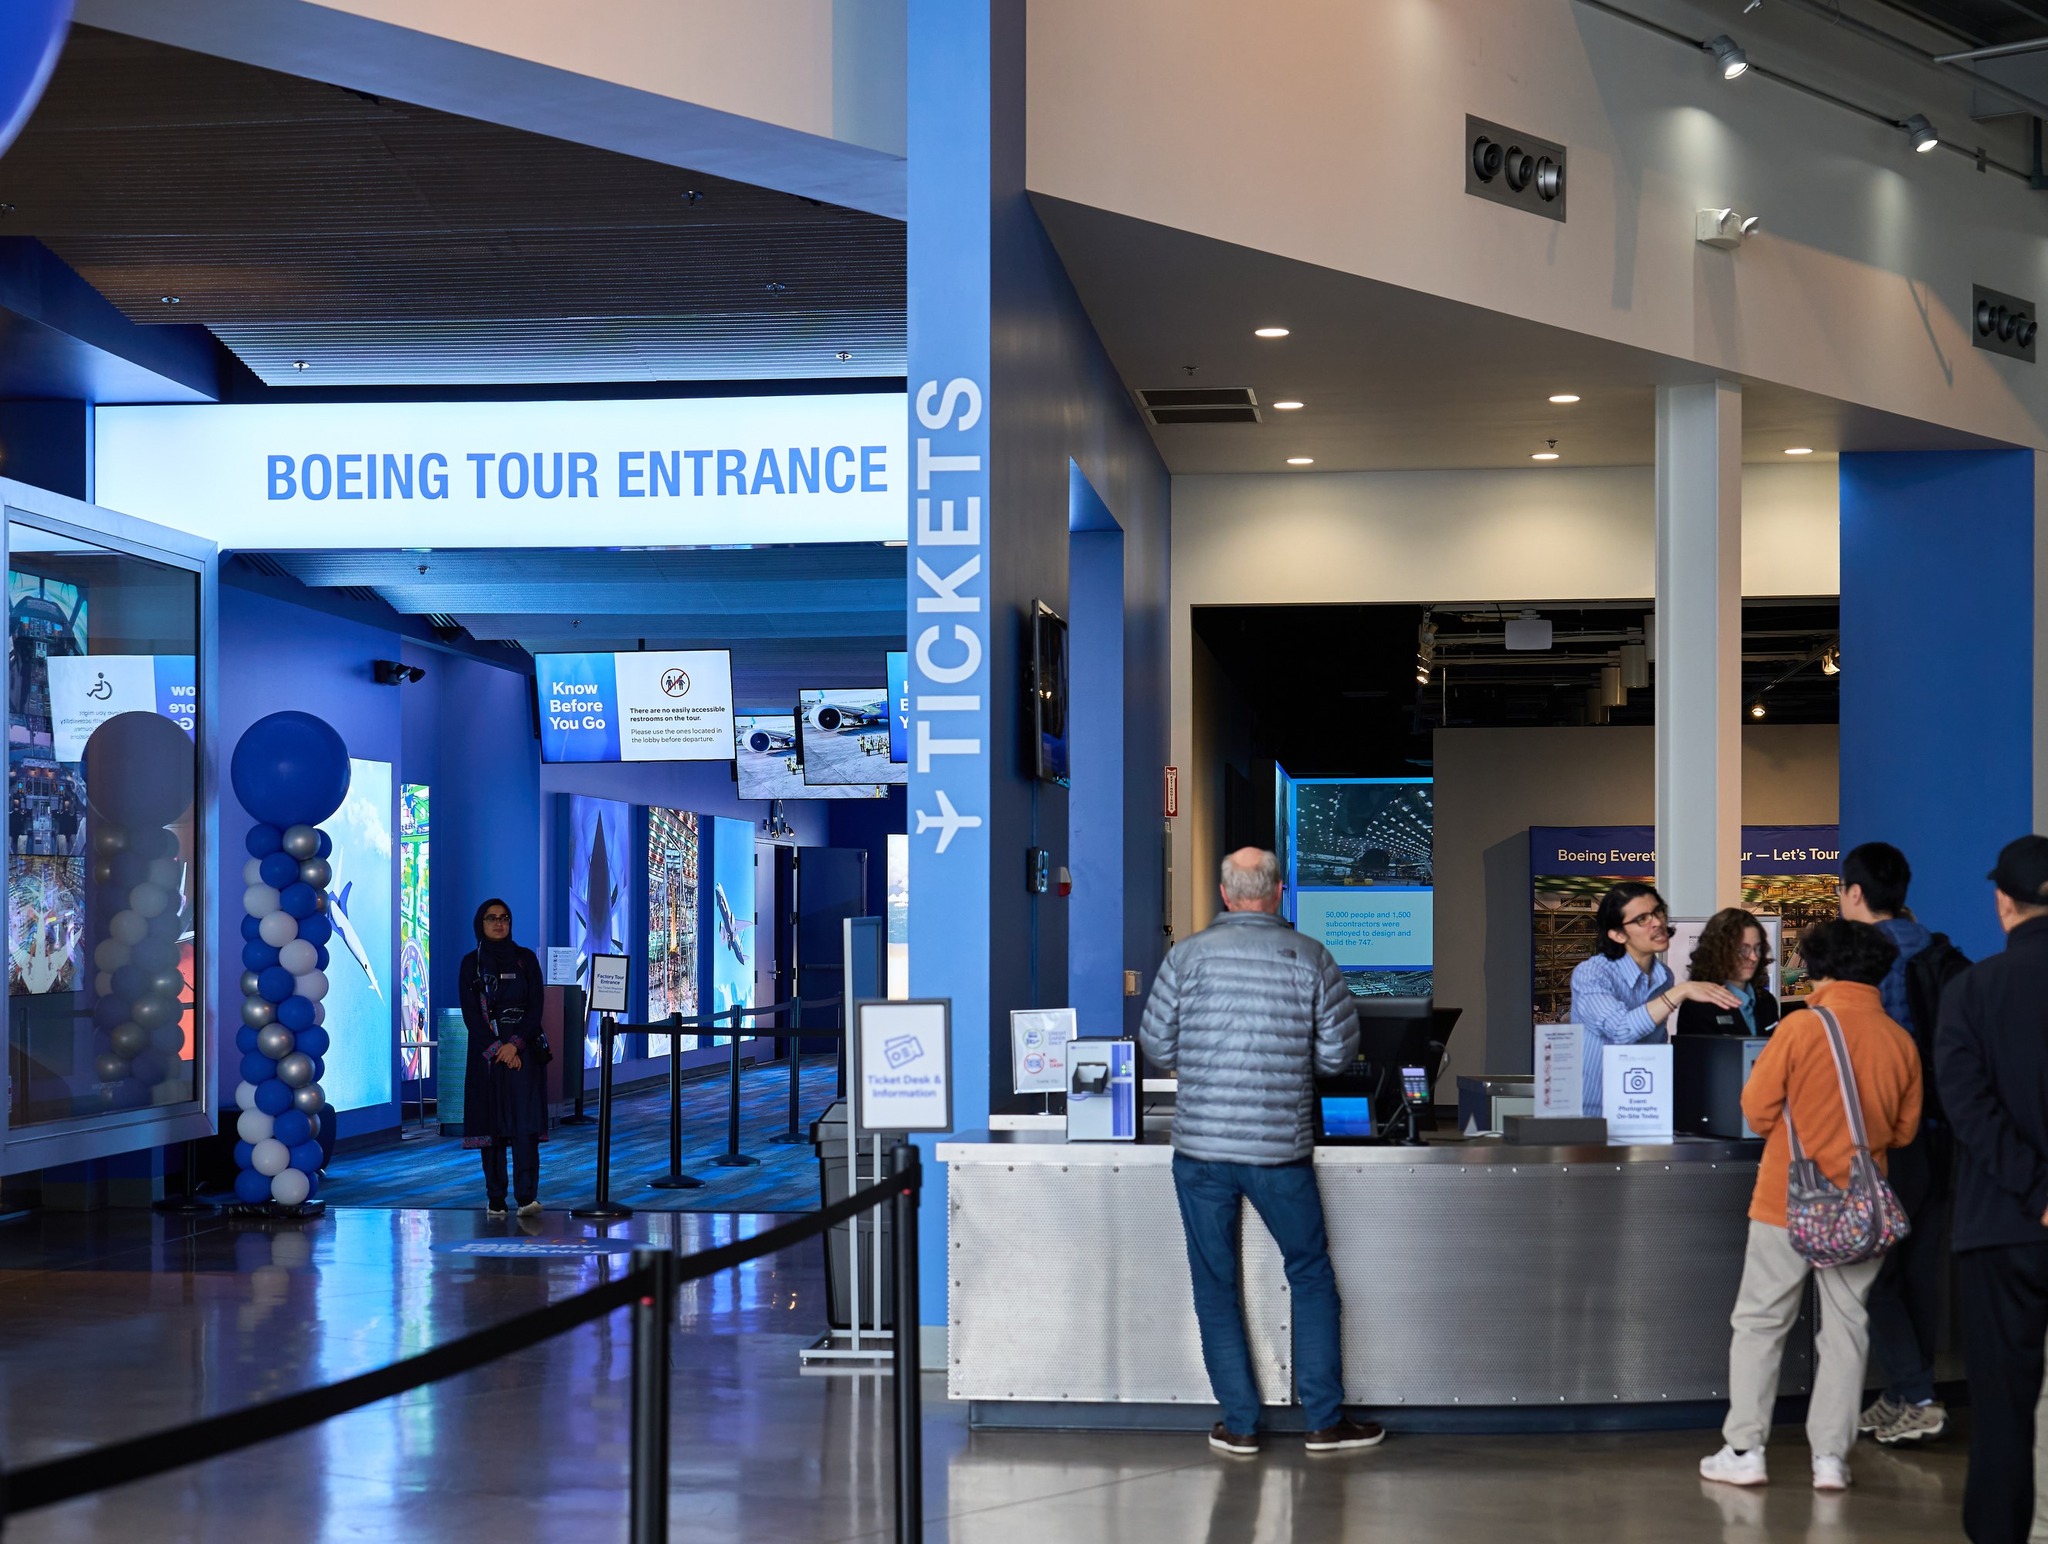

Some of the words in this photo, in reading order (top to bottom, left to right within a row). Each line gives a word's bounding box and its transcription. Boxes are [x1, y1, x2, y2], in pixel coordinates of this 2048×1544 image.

[266, 452, 449, 501] BOEING
[467, 450, 599, 500] TOUR
[618, 445, 888, 499] ENTRANCE
[915, 376, 982, 773] TICKETS
[552, 681, 598, 695] Know
[549, 699, 603, 713] Before
[672, 706, 690, 714] easily
[549, 716, 579, 730] You
[582, 716, 606, 730] Go
[682, 736, 714, 744] departure.
[1557, 849, 1607, 864] Boeing
[1610, 850, 1656, 862] Everet
[1740, 851, 1753, 861] ur
[1773, 848, 1806, 861] Let's
[1809, 848, 1840, 860] Tour
[1372, 930, 1396, 938] design
[868, 1075, 900, 1084] Ticket
[903, 1075, 930, 1084] Desk
[934, 1075, 942, 1084] &
[872, 1089, 937, 1098] Information
